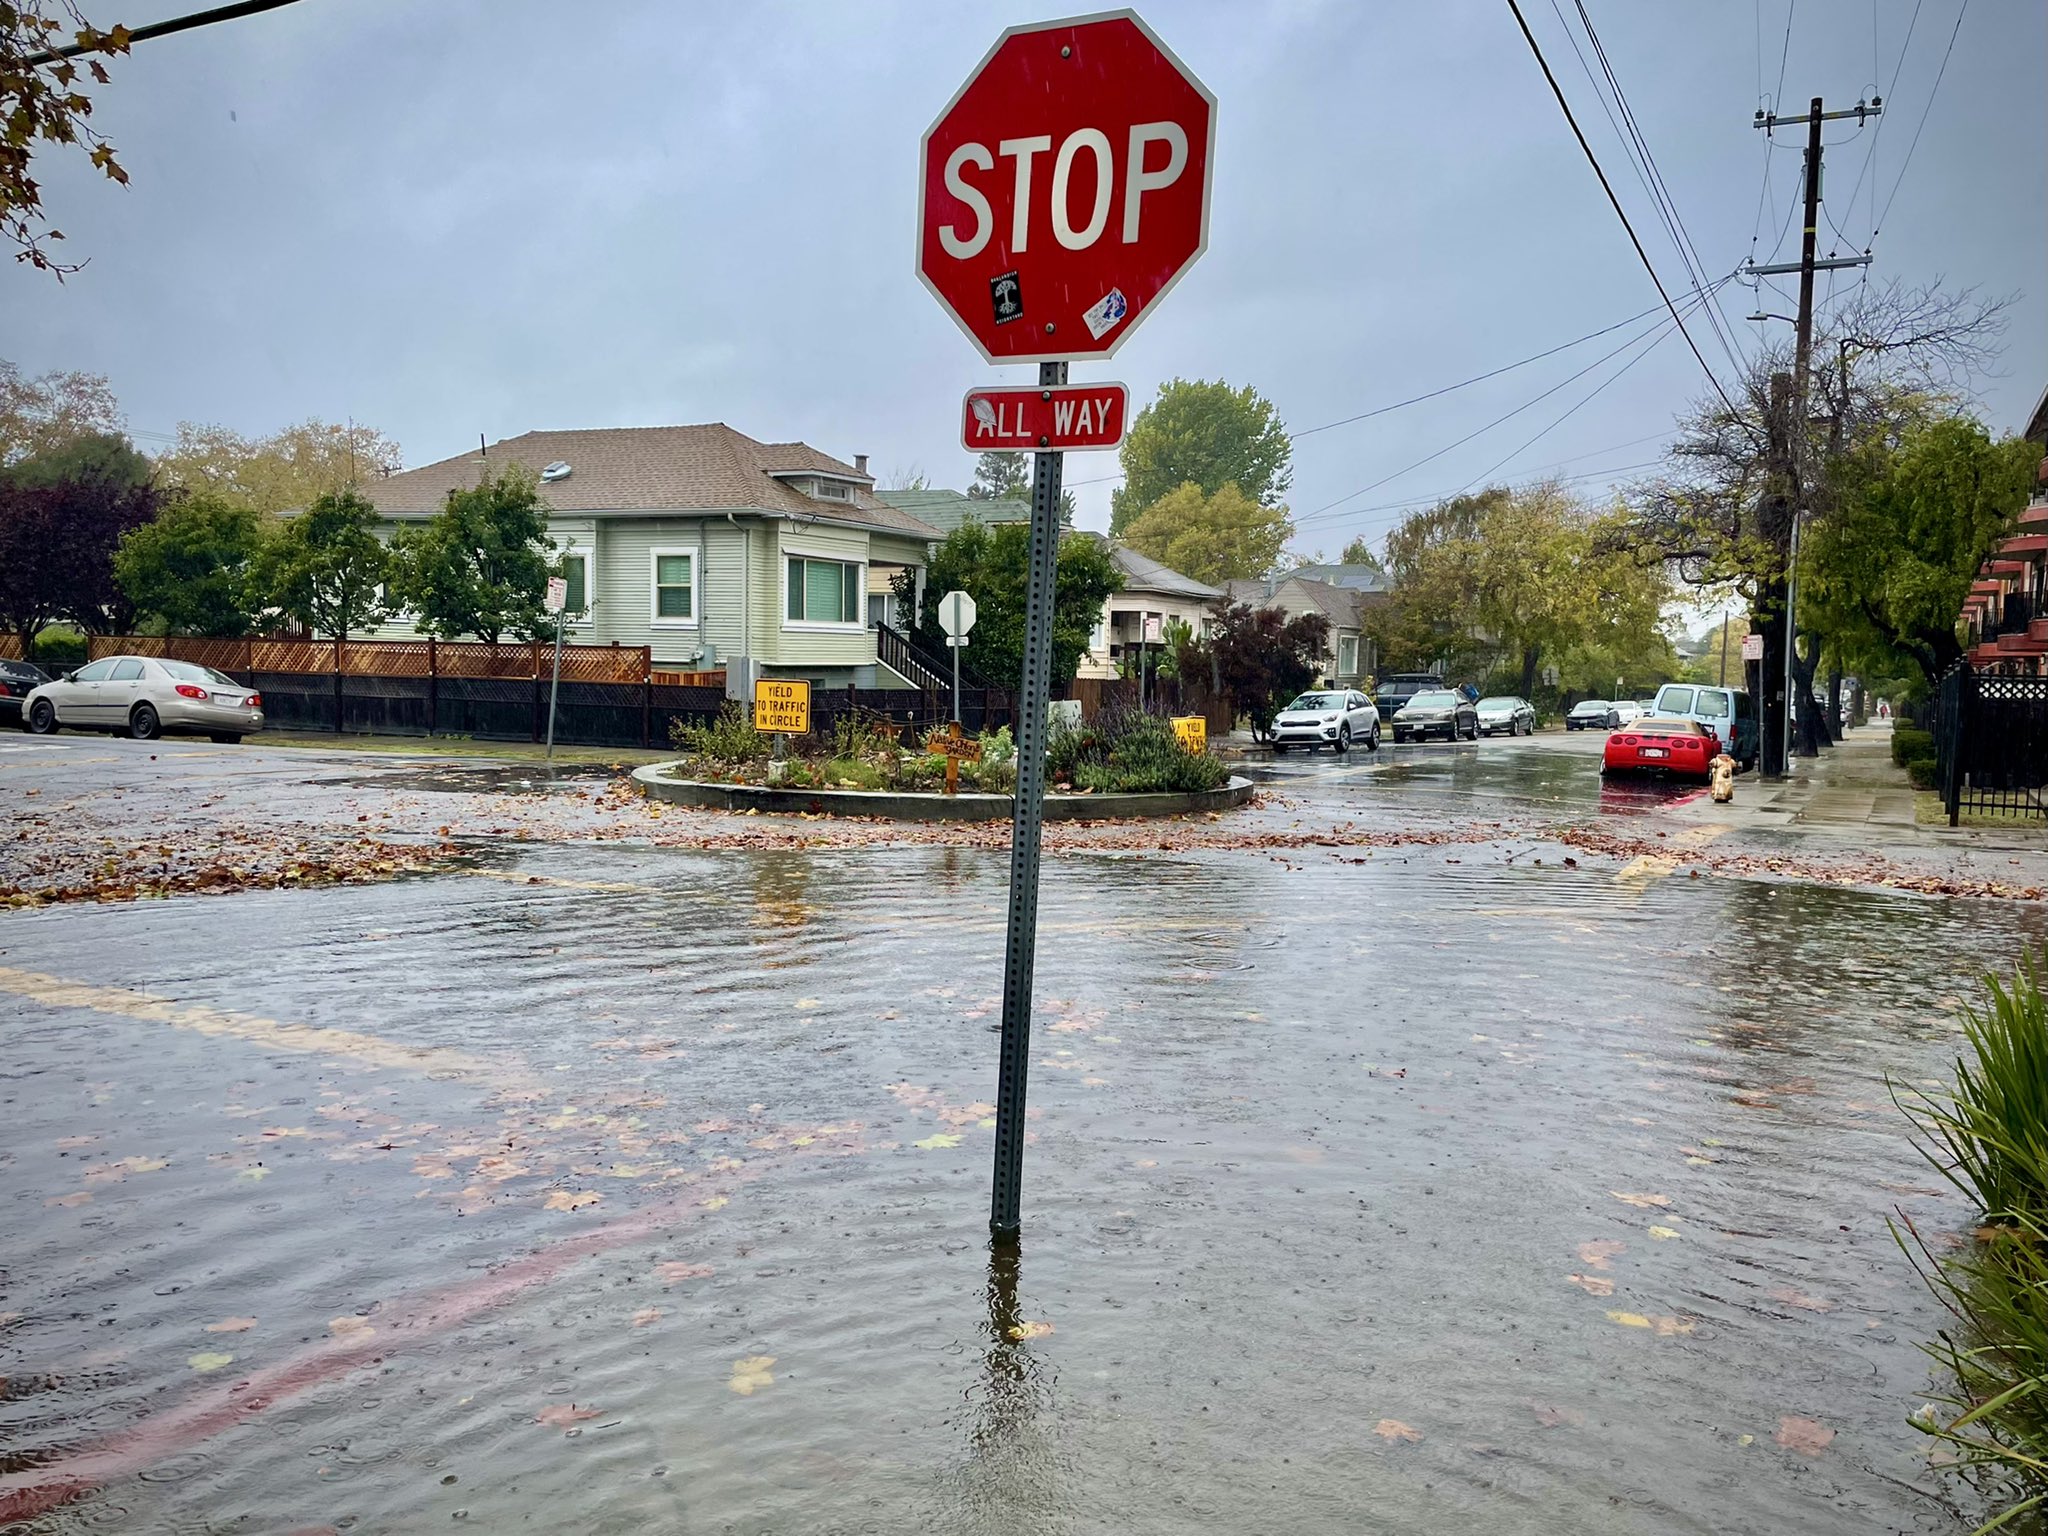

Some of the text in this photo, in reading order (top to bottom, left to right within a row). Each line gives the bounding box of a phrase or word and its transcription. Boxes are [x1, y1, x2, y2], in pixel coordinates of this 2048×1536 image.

[939, 121, 1188, 260] STOP
[1054, 398, 1112, 436] WAY
[768, 686, 793, 698] YIELD
[757, 700, 806, 713] TO TRAFFIC
[760, 714, 801, 727] IN CIRCLE
